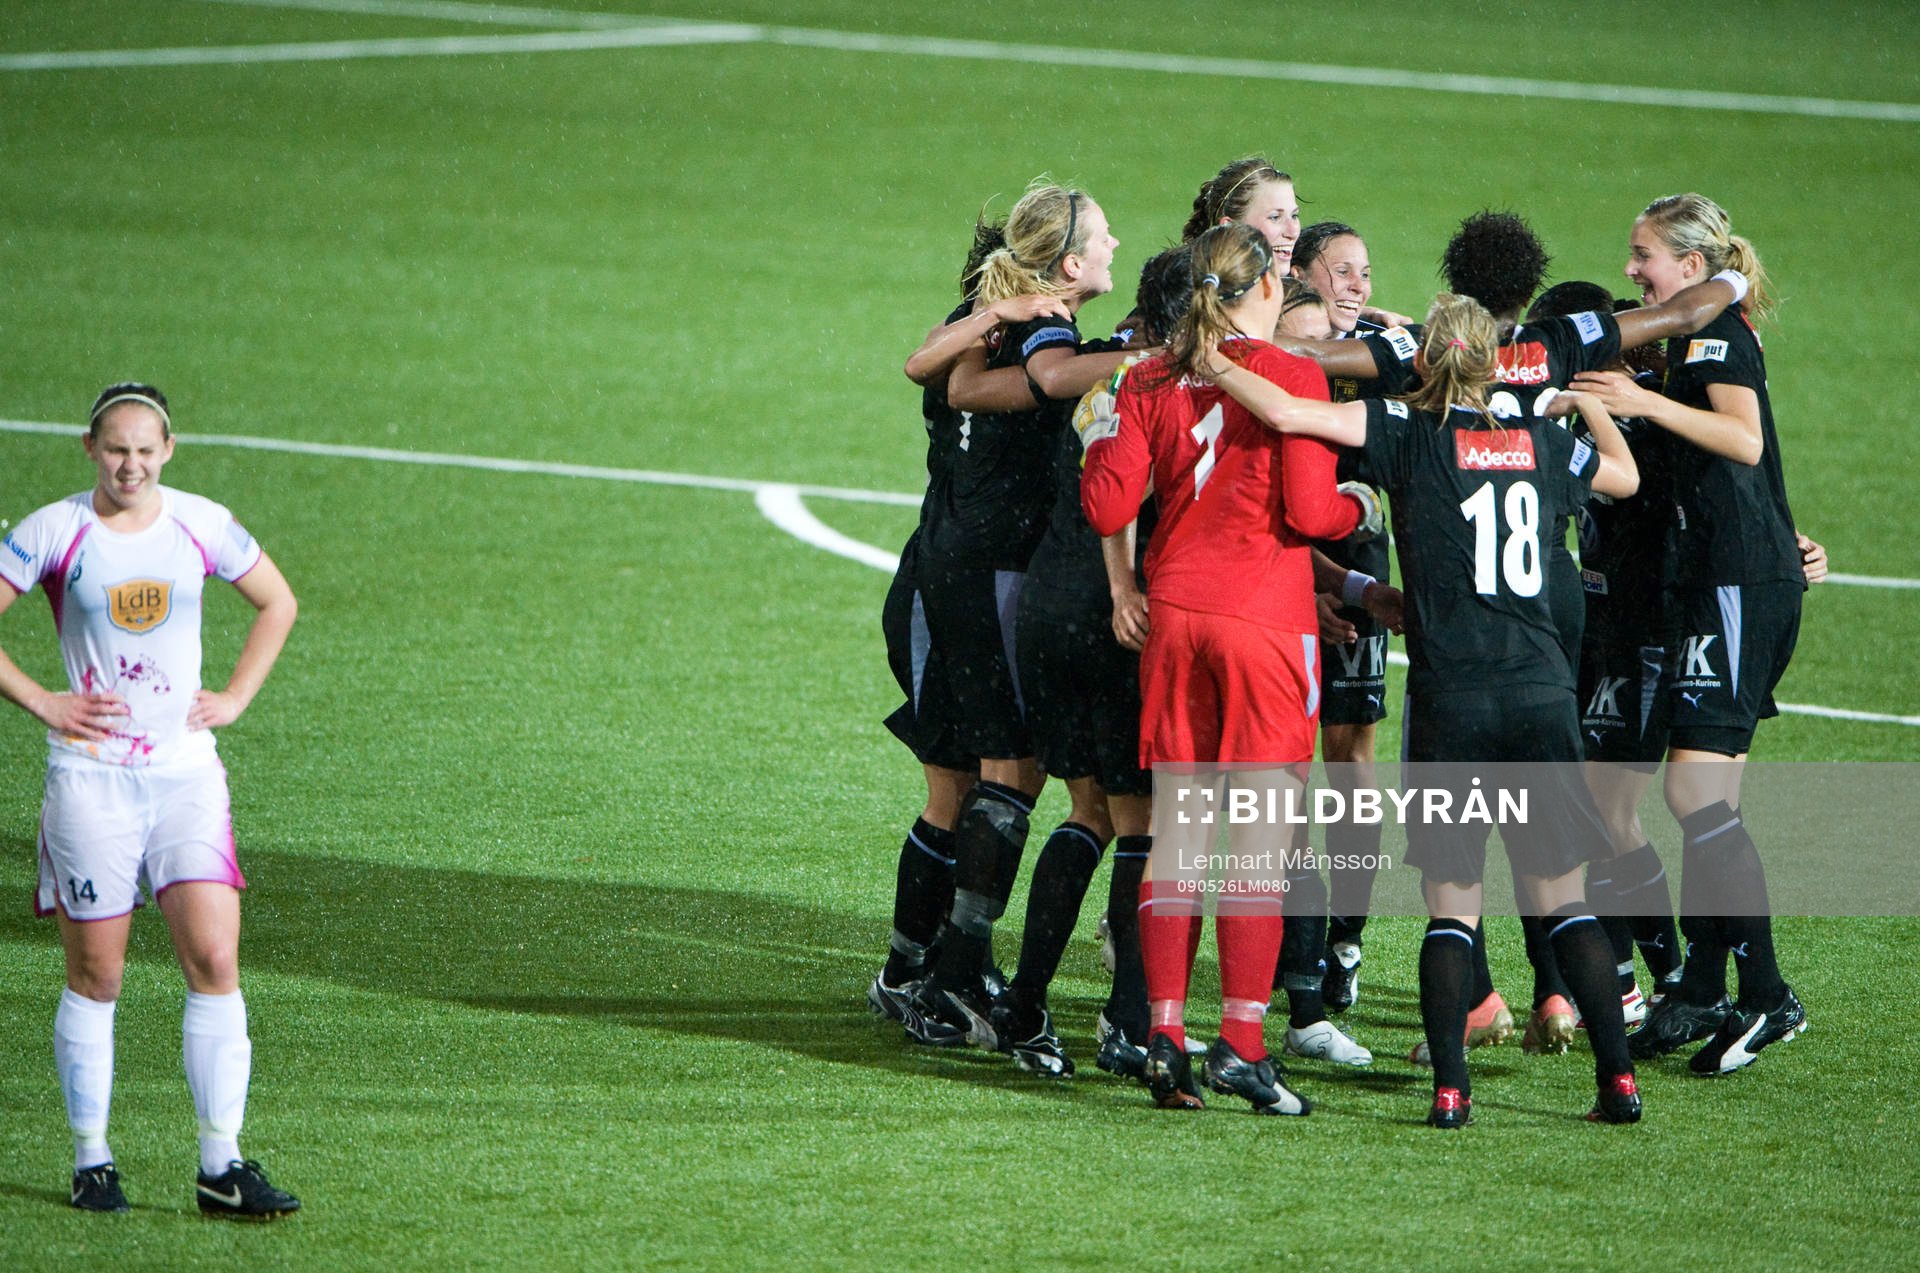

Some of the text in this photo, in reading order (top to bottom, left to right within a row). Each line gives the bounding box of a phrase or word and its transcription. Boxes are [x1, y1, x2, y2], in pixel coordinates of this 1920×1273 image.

[1393, 336, 1414, 355] put
[1704, 344, 1723, 358] put
[1177, 372, 1216, 390] Ade
[1465, 447, 1531, 467] Adecco
[1459, 480, 1543, 598] 18
[118, 587, 161, 610] LdB
[68, 879, 98, 903] 14
